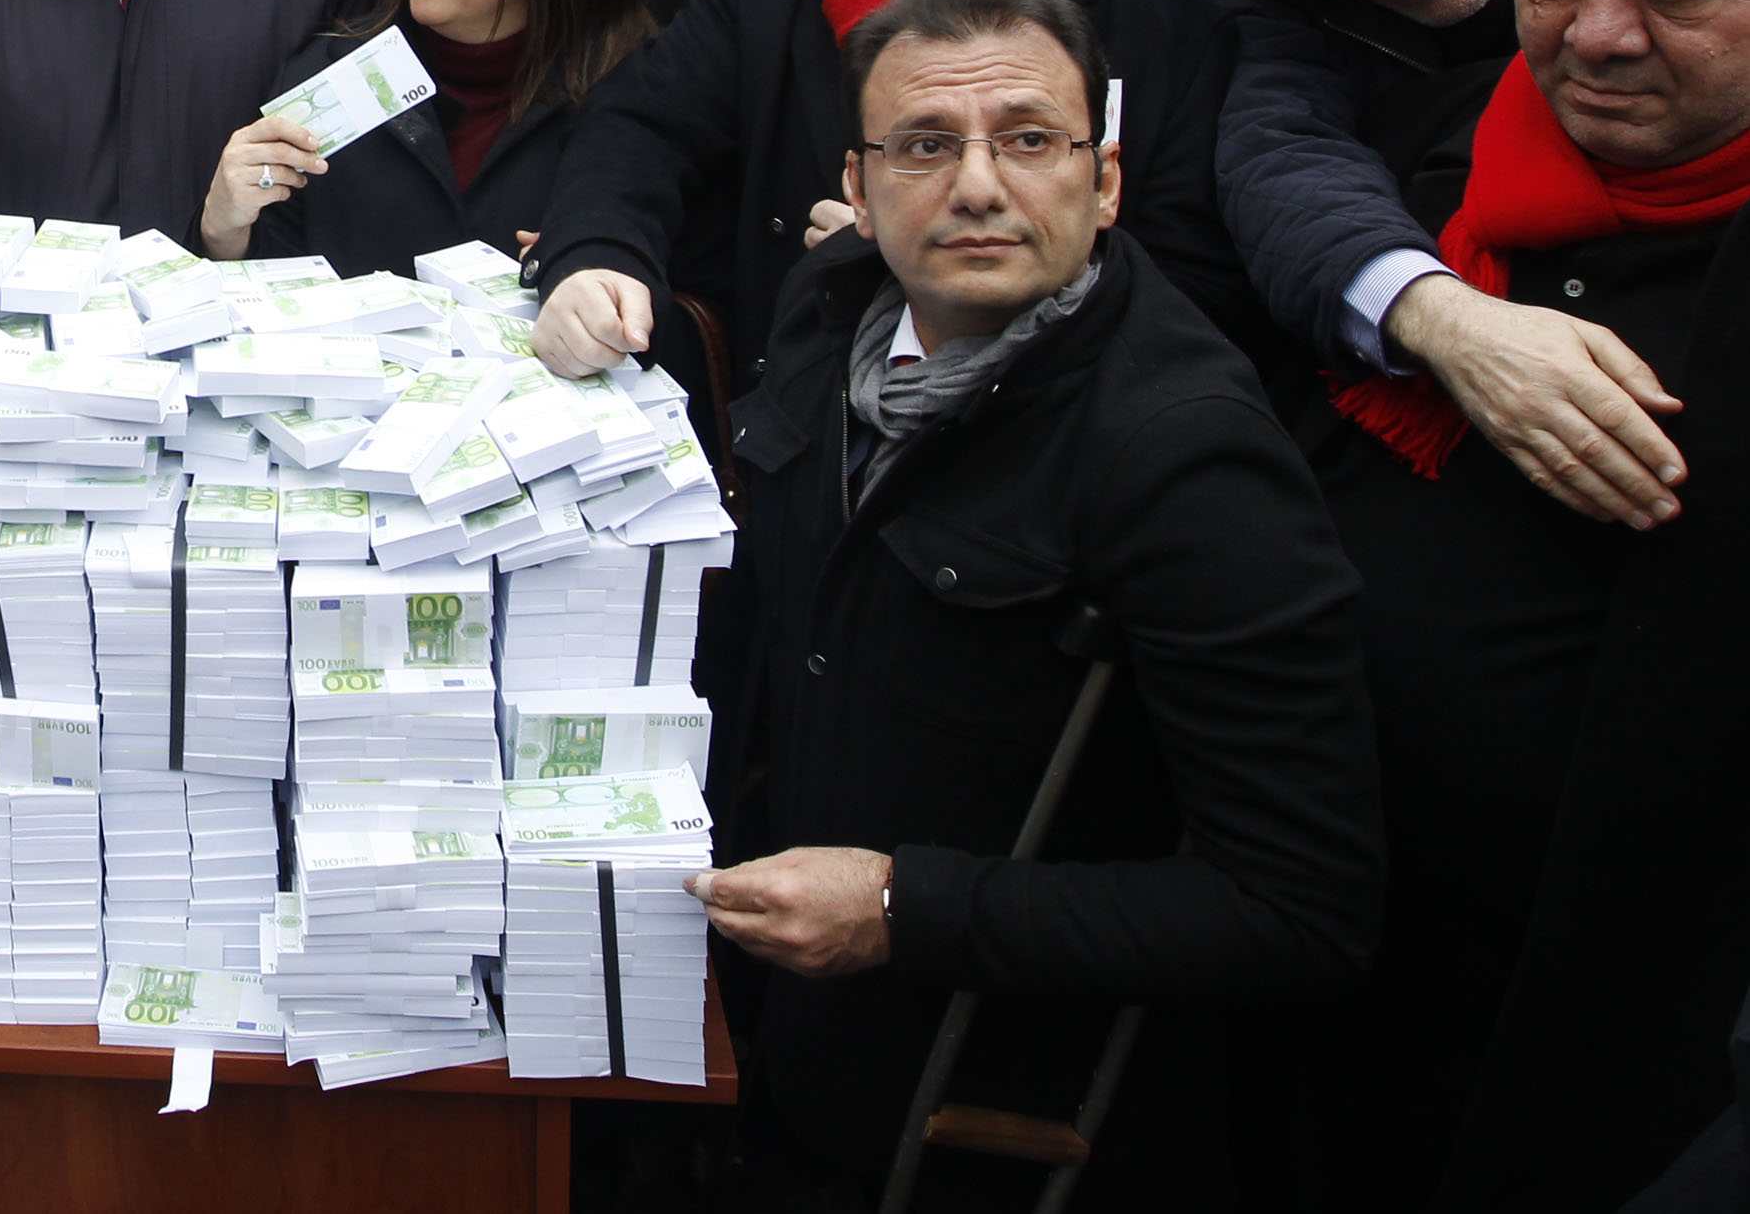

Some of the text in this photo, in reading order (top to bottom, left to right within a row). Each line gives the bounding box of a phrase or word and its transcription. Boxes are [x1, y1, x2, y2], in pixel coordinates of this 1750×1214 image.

[401, 84, 428, 105] 100
[406, 594, 463, 621] 100
[299, 658, 325, 671] 100
[321, 672, 383, 692] 100
[65, 720, 93, 735] 100
[676, 716, 706, 728] 100
[671, 817, 705, 832] 100
[123, 1000, 181, 1025] 100
